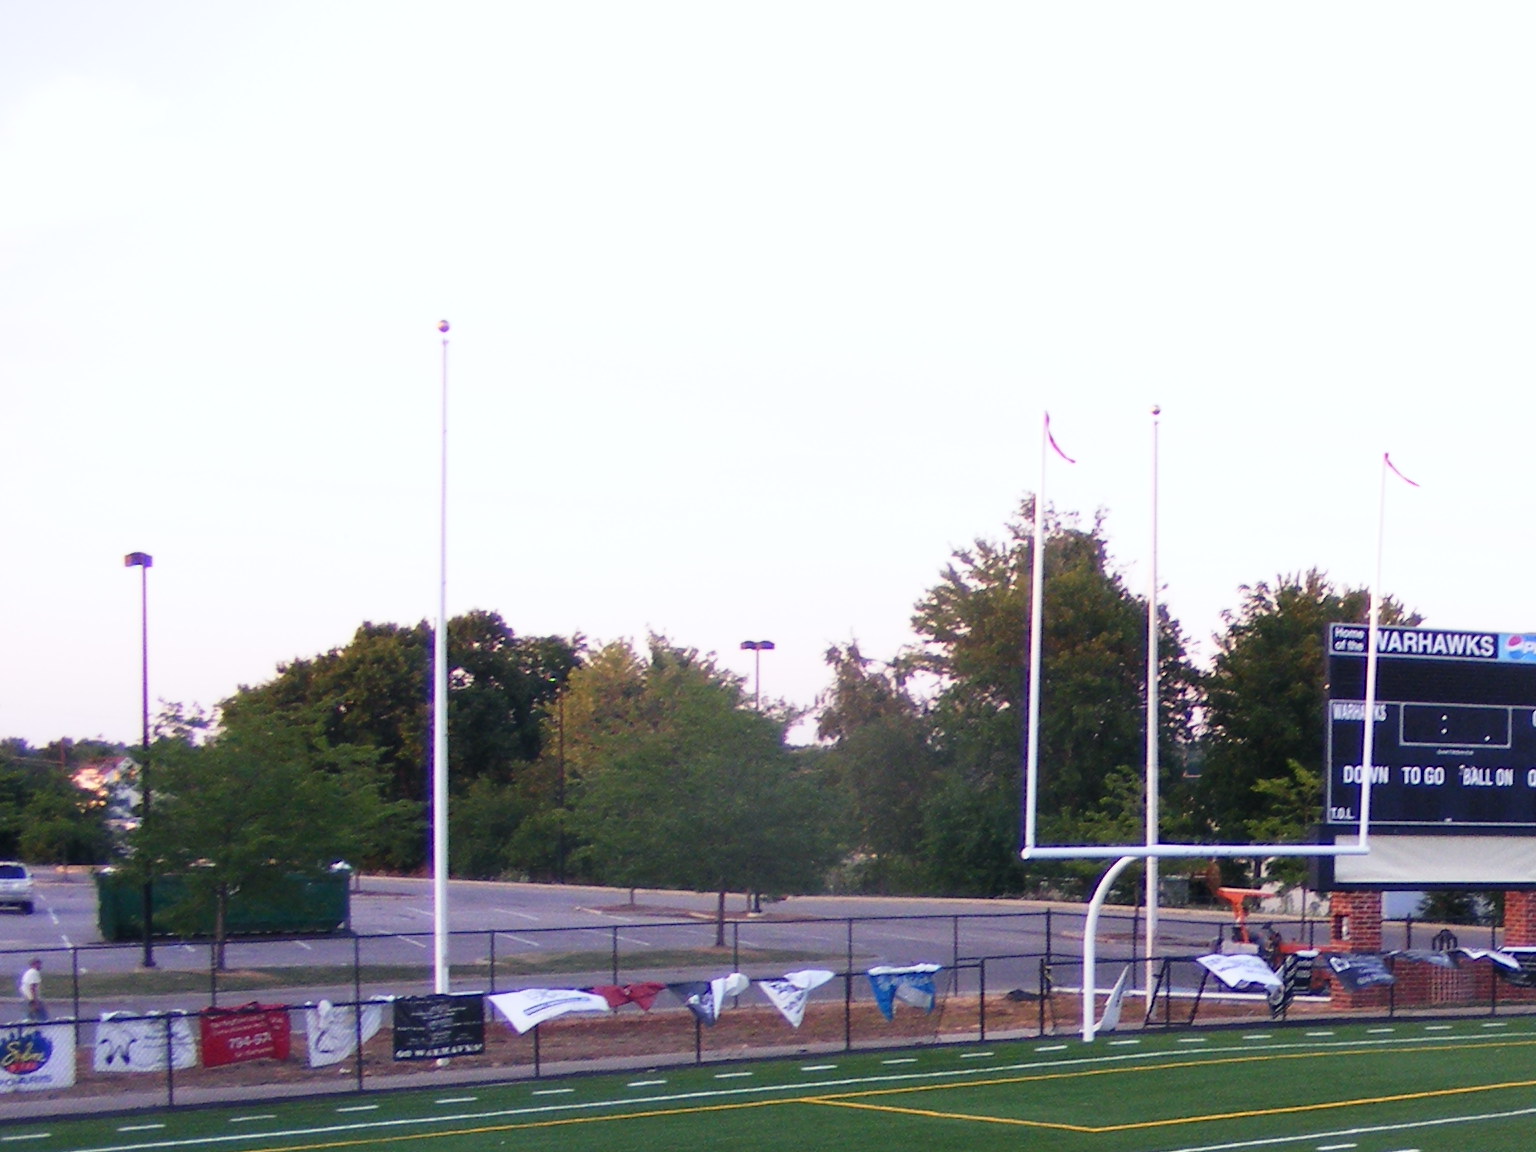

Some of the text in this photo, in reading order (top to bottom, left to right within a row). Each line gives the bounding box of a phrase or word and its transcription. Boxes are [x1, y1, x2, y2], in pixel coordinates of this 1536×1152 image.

[1334, 626, 1365, 639] Home
[1334, 639, 1365, 652] of the
[1376, 629, 1495, 657] WARHAWKS
[1343, 765, 1389, 784] DOWN
[1401, 766, 1445, 785] TO GO
[1462, 767, 1514, 787] BALL ON
